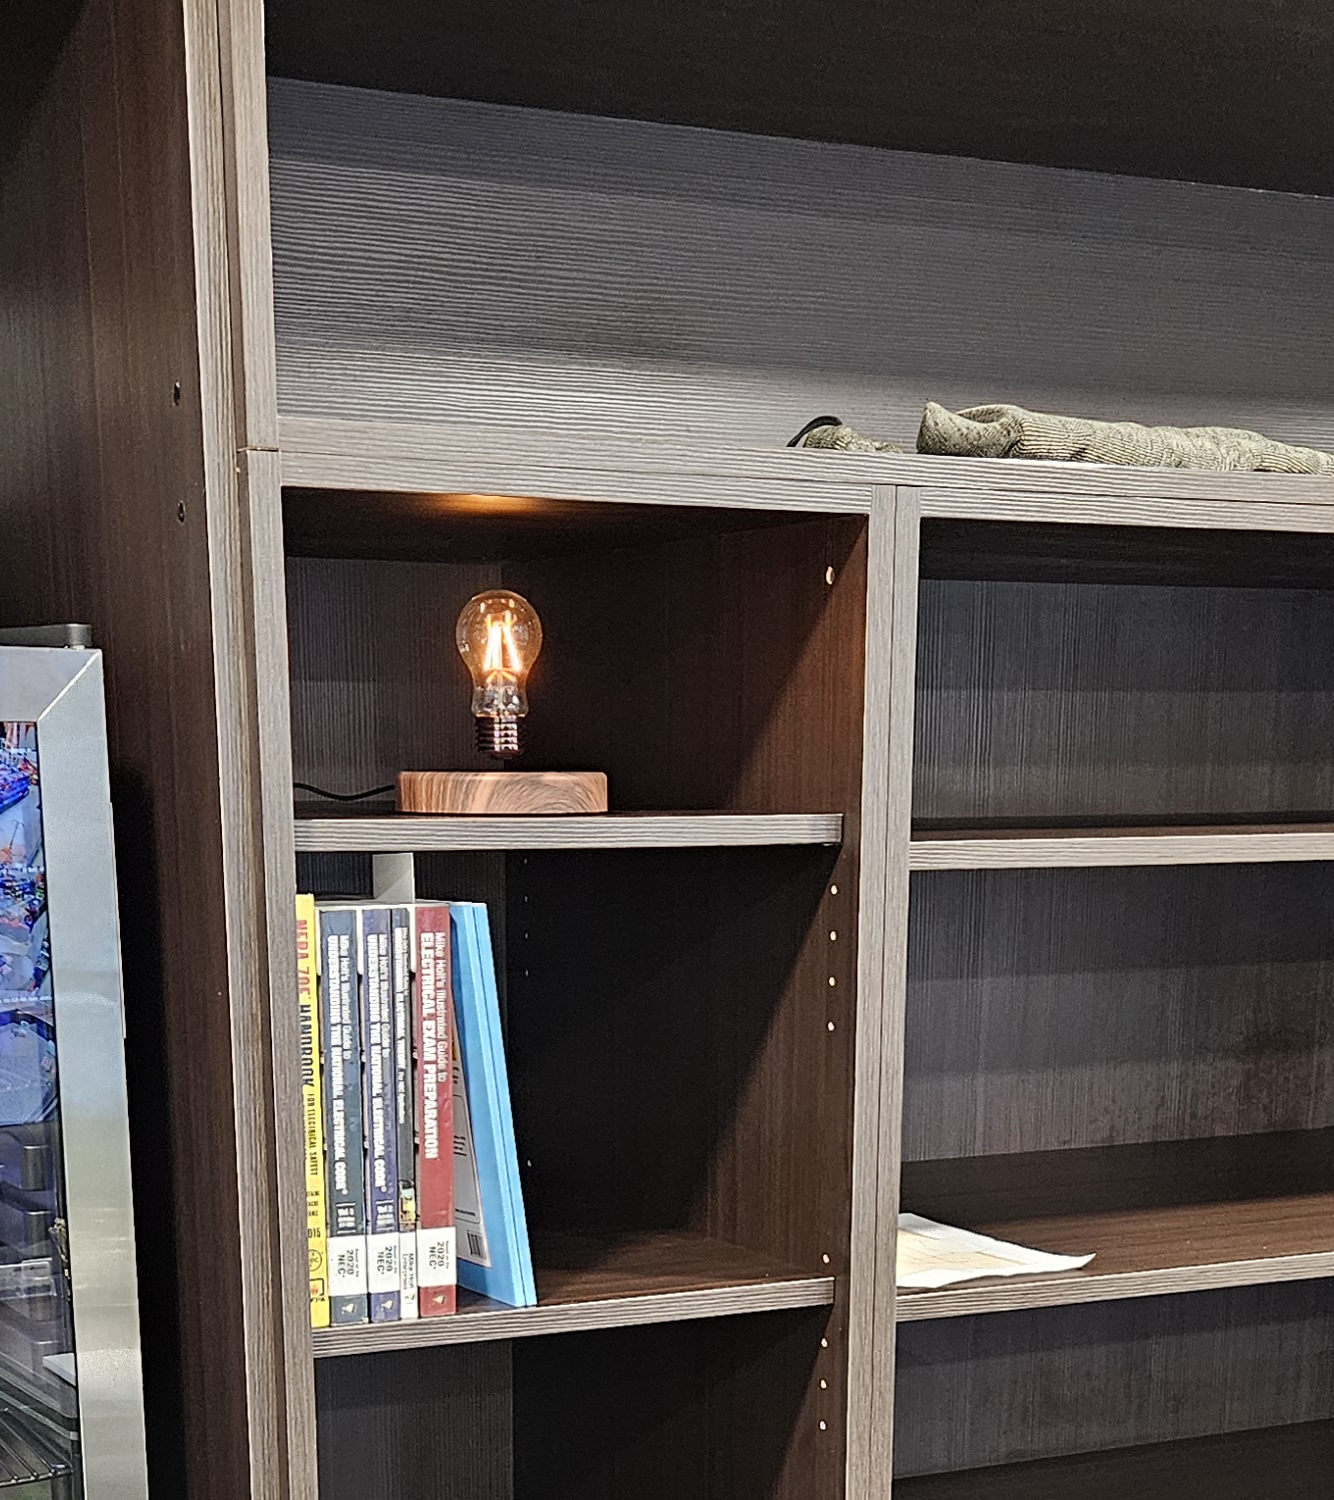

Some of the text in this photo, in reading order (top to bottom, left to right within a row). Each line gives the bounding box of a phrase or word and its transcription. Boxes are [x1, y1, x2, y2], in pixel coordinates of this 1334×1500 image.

[340, 934, 350, 957] Mike
[379, 933, 388, 956] Mike
[328, 934, 341, 1024] UNDERSTANDING
[367, 933, 381, 1023] UNDERSTANDING
[435, 931, 449, 1083] Mike Holt's Illustrated Guide to
[330, 1024, 342, 1047] THE
[342, 1025, 353, 1050] Guide
[370, 1023, 381, 1045] THE
[381, 1023, 391, 1048] Guide
[420, 931, 439, 1159] ELECTRICAL EXAM PREPARATION
[331, 1047, 345, 1099] NATIONAL
[371, 1045, 383, 1097] NATIONAL
[333, 1099, 346, 1160] ELECTRICAL
[372, 1097, 385, 1158] ELECTRICAL
[307, 1227, 322, 1239] 015
[346, 1249, 355, 1276] 2020
[385, 1246, 393, 1272] 2020
[437, 1241, 445, 1267] 2020
